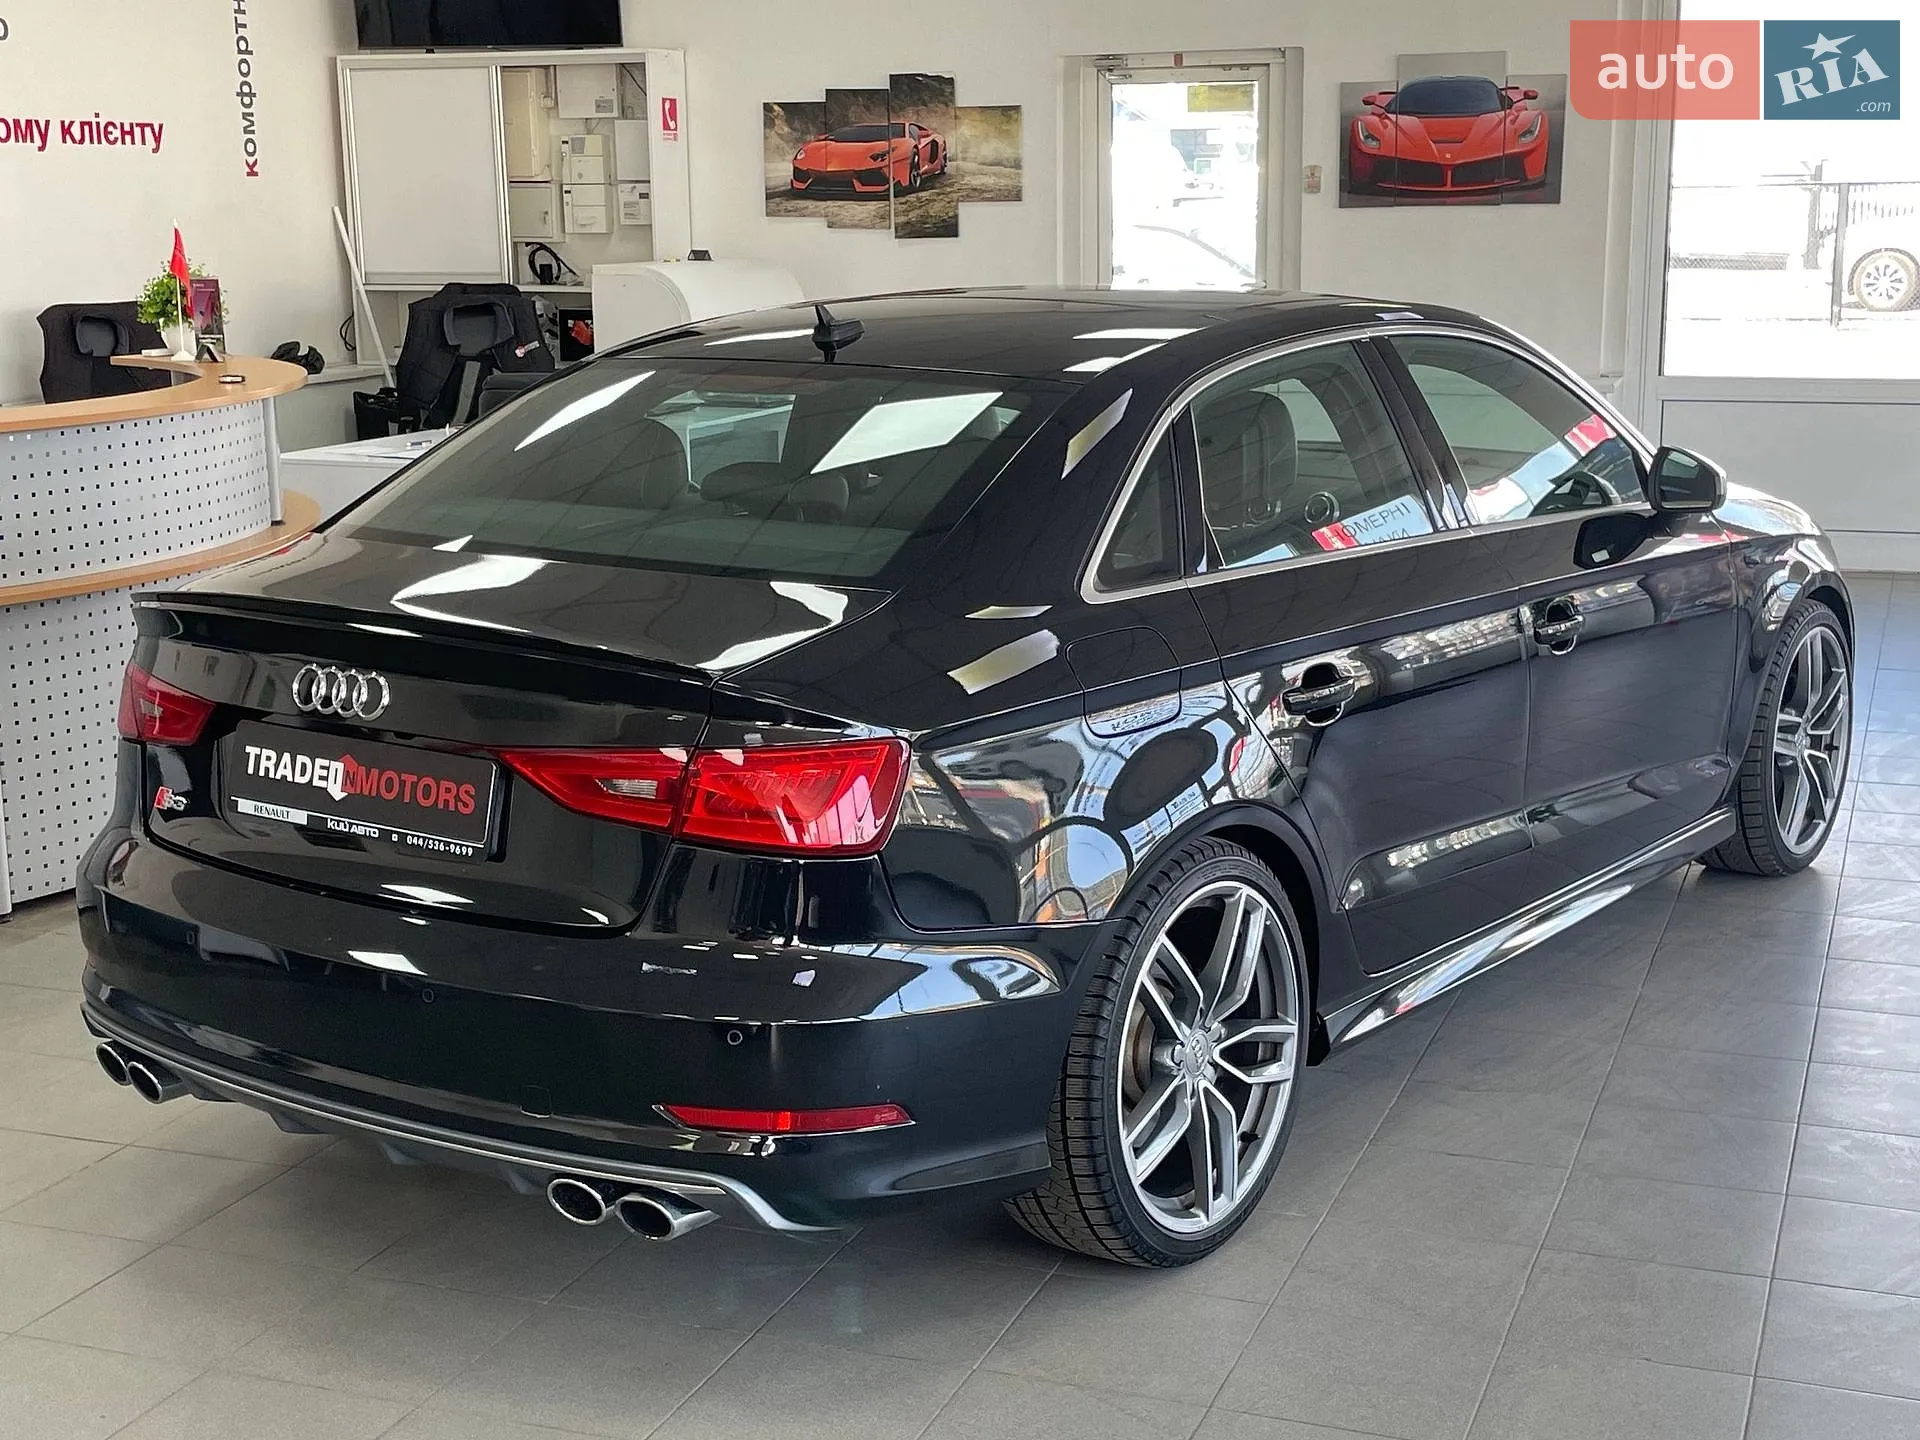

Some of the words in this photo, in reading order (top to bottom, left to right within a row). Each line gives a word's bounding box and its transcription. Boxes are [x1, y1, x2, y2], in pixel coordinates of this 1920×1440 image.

[59, 112, 164, 153] клієнту
[253, 804, 291, 820] RENAULT
[406, 835, 473, 857] 044/536-9699
